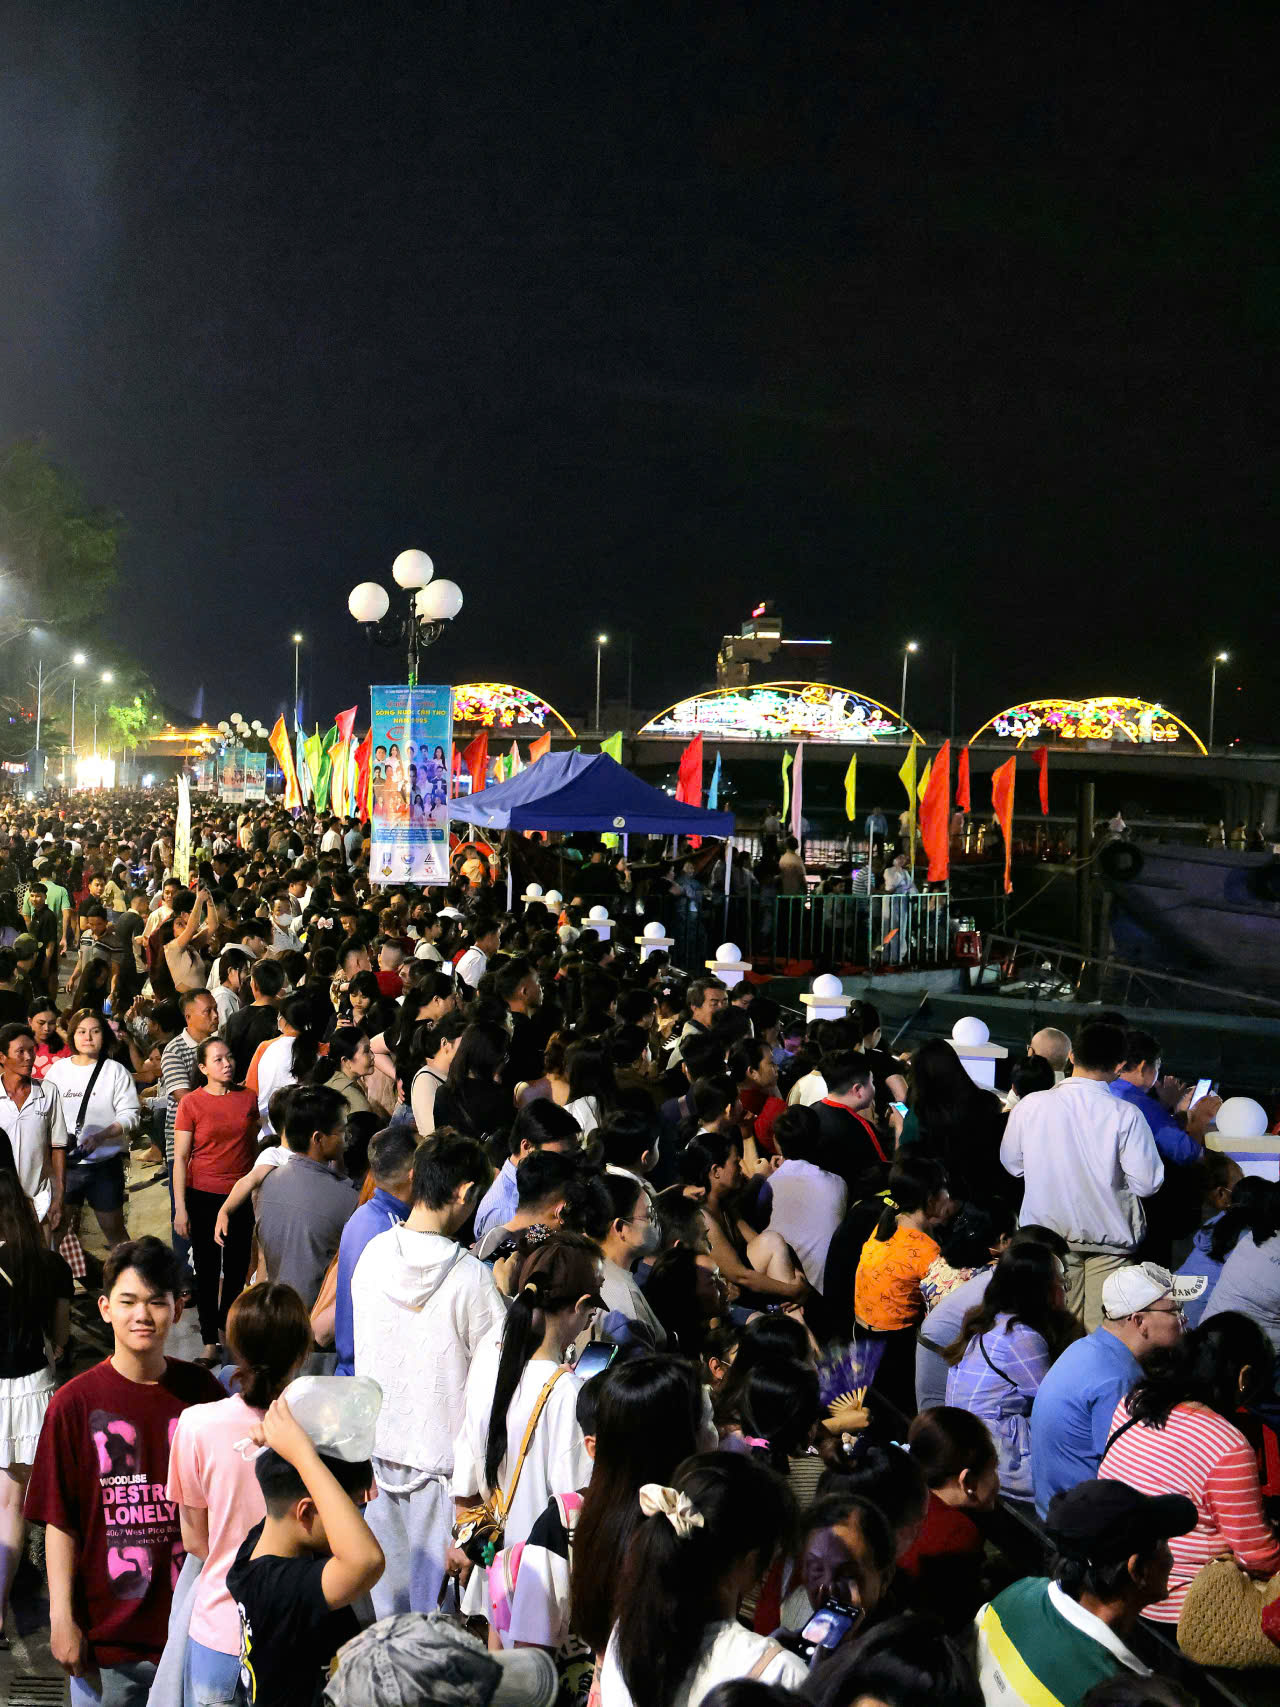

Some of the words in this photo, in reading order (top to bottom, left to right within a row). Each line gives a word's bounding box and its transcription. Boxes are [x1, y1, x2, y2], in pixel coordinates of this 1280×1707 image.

[100, 1474, 147, 1486] WOODLISE
[102, 1483, 167, 1504] DESTR
[103, 1503, 177, 1526] LONELY
[125, 1528, 145, 1536] West
[147, 1527, 165, 1535] Pico
